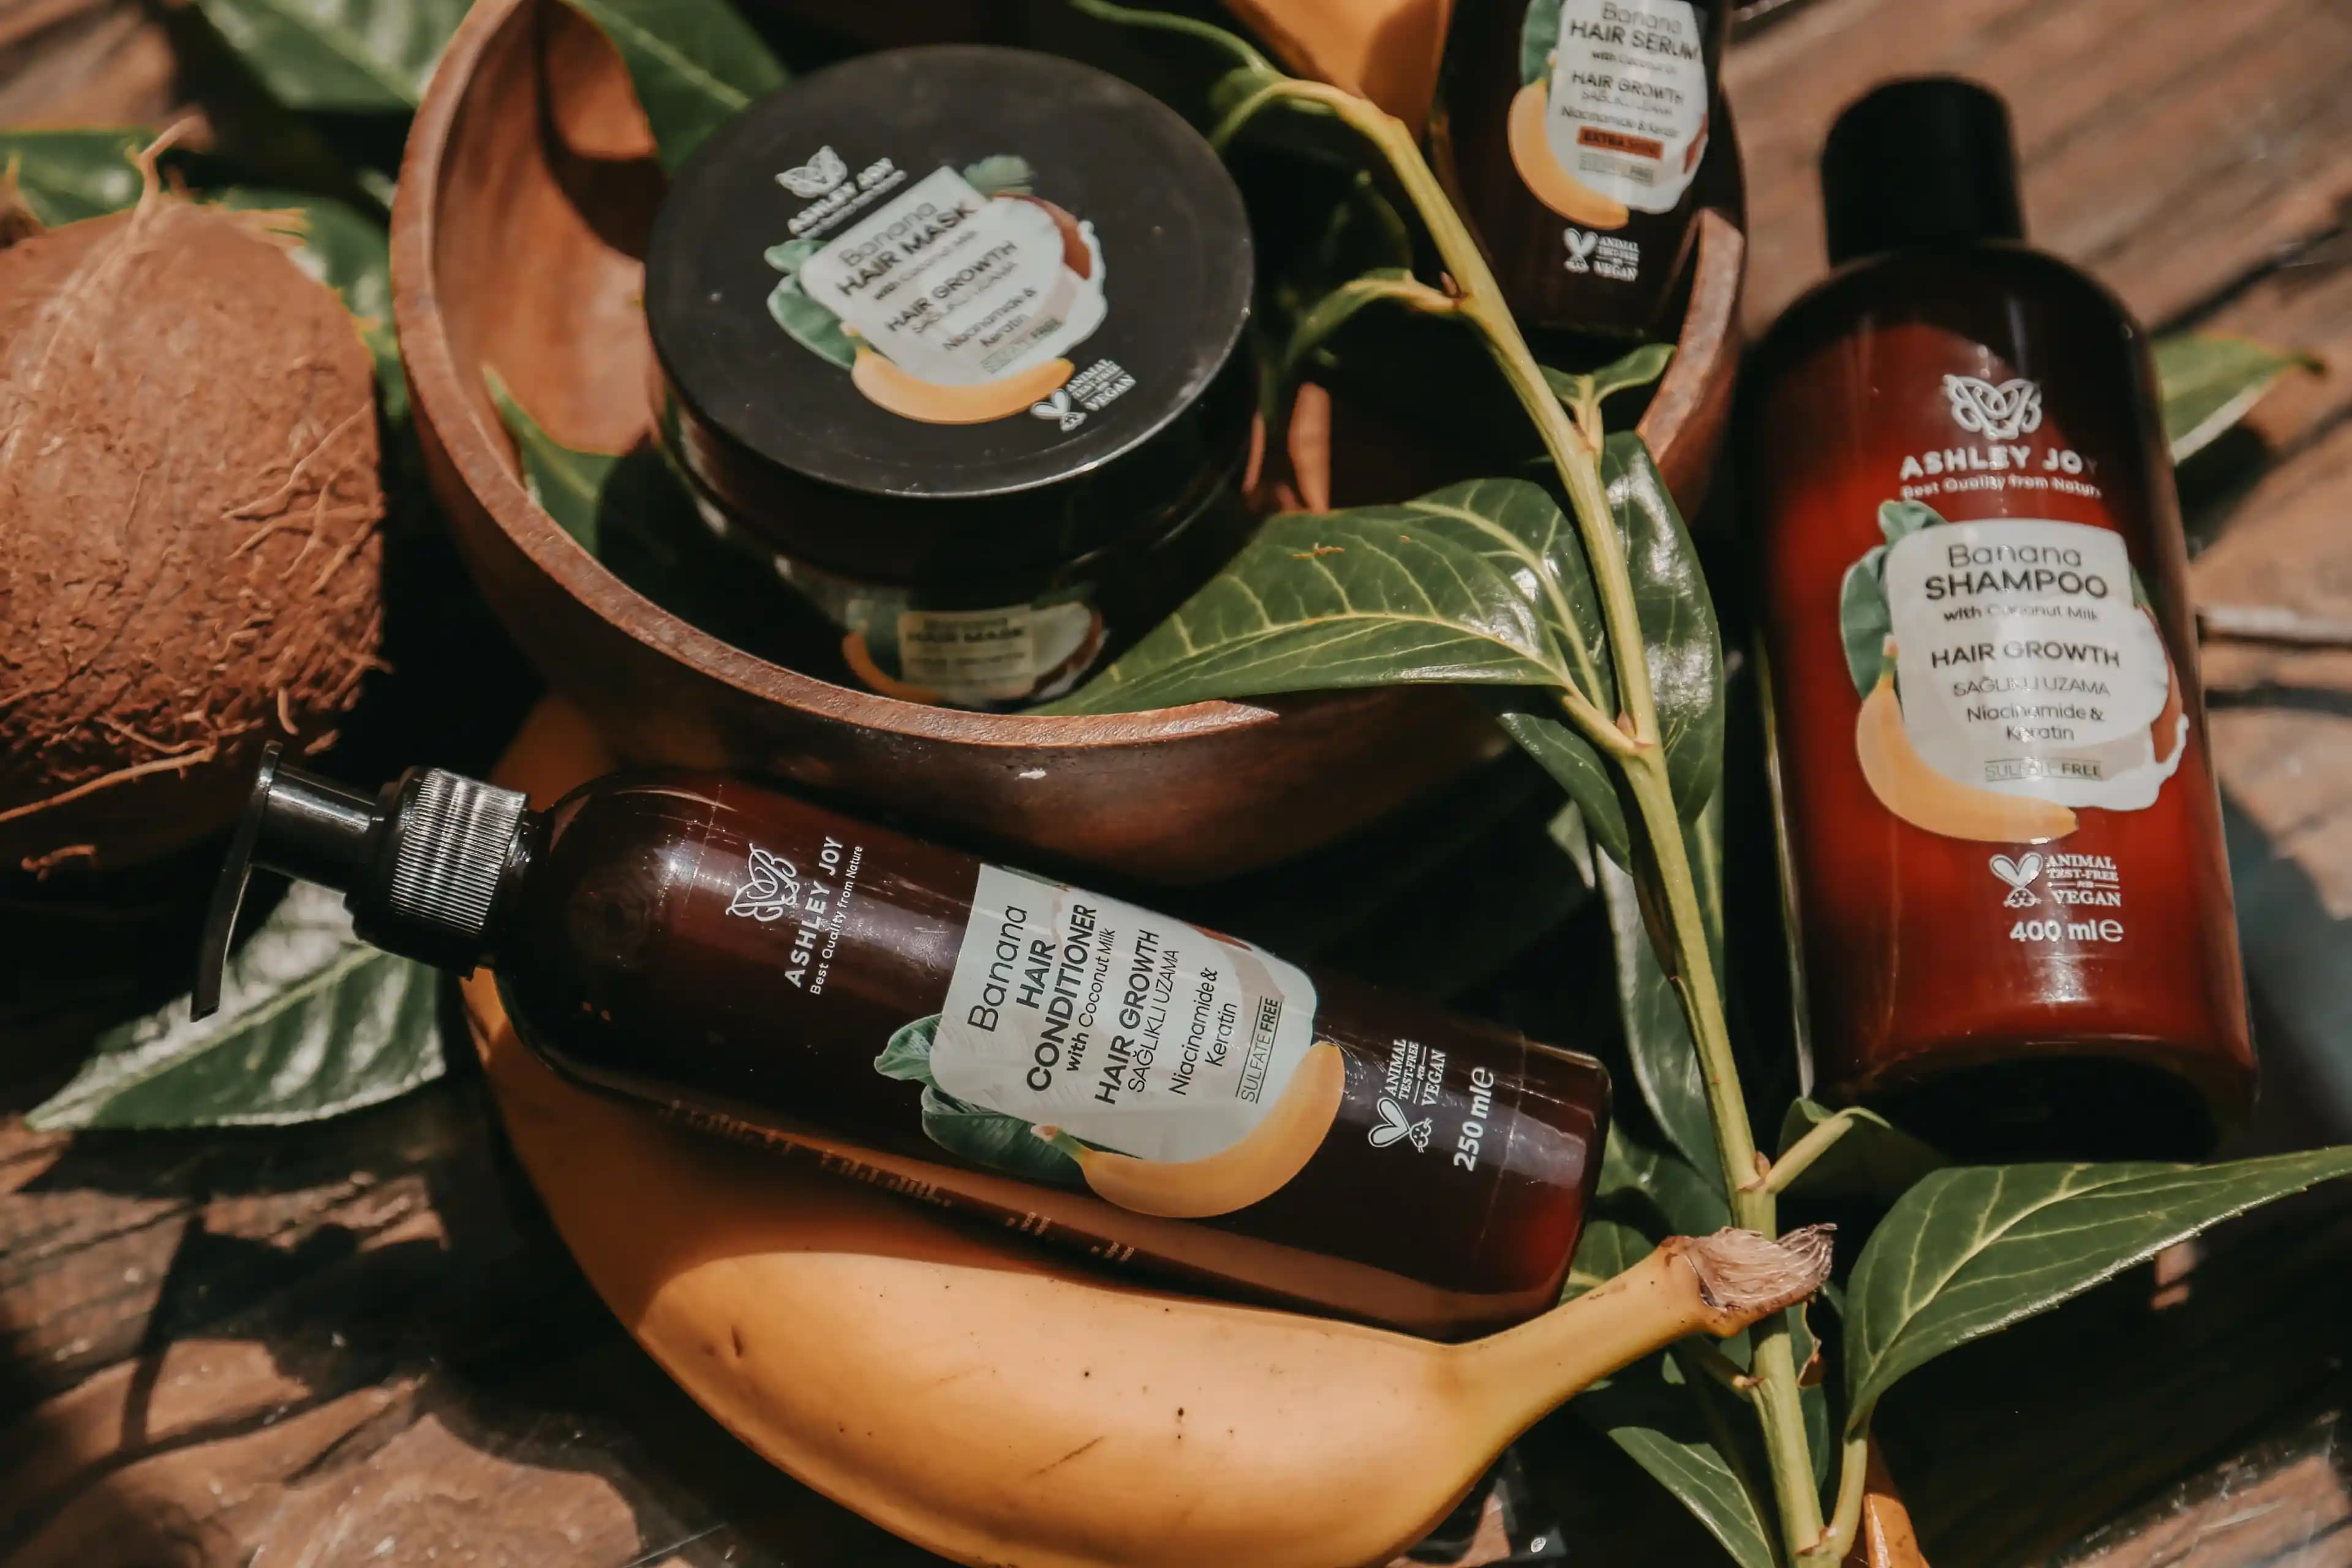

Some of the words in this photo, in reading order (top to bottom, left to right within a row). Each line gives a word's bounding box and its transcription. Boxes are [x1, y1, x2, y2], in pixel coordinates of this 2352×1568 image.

[1570, 19, 1626, 45] HAIR
[1602, 2, 1683, 35] Banana
[1571, 70, 1614, 90] HAIR
[1618, 79, 1685, 106] GROWTH
[835, 250, 902, 296] HAIR
[899, 200, 978, 255] MASK
[839, 202, 938, 267] Banana
[885, 296, 934, 333] HAIR
[932, 239, 1019, 299] GROWTH
[1083, 374, 1136, 412] VEGAN
[1900, 445, 2032, 481] ASHLEY
[1942, 475, 2005, 492] Quality
[1948, 543, 2082, 568] Banana
[1925, 569, 2108, 601] SHAMPOO
[1943, 606, 1982, 623] with
[2067, 605, 2099, 621] Milk
[1931, 643, 1995, 669] HAIR
[2003, 640, 2120, 668] GROWTH
[2043, 676, 2112, 696] UZAMA
[1967, 703, 2087, 723] Niacinamide
[2090, 707, 2105, 722] &
[845, 845, 864, 879] Nature
[2046, 869, 2119, 882] TEST-FREE
[2047, 853, 2116, 870] ANIMAL
[785, 880, 830, 988] ASHLEY
[818, 836, 843, 876] JOY
[837, 879, 854, 910] from
[2051, 889, 2122, 907] VEGAN
[821, 911, 847, 959] Quality
[2010, 919, 2062, 943] 400
[810, 962, 829, 995] Best
[967, 905, 1028, 1033] Banana
[1016, 940, 1057, 1009] HAIR
[1026, 904, 1098, 1091] CONDITIONER
[1066, 1032, 1090, 1072] with
[1078, 954, 1110, 1028] Coconut
[1099, 927, 1116, 955] Milk
[1095, 1035, 1136, 1105] HAIR
[1118, 929, 1160, 1030] GROWTH
[1127, 1006, 1167, 1093] SAĞLIKLI
[1153, 949, 1180, 1004] UZAMA
[1168, 979, 1216, 1096] Niacinamide
[1199, 967, 1218, 982] &
[1204, 1002, 1238, 1067] Keratin
[1241, 1035, 1271, 1102] SULFATE
[1259, 997, 1279, 1034] FREE
[1384, 1038, 1407, 1097] ANIMAL
[1398, 1041, 1419, 1100] TEST-FREE
[1421, 1049, 1446, 1106] VEGAN
[1453, 1121, 1484, 1172] 250
